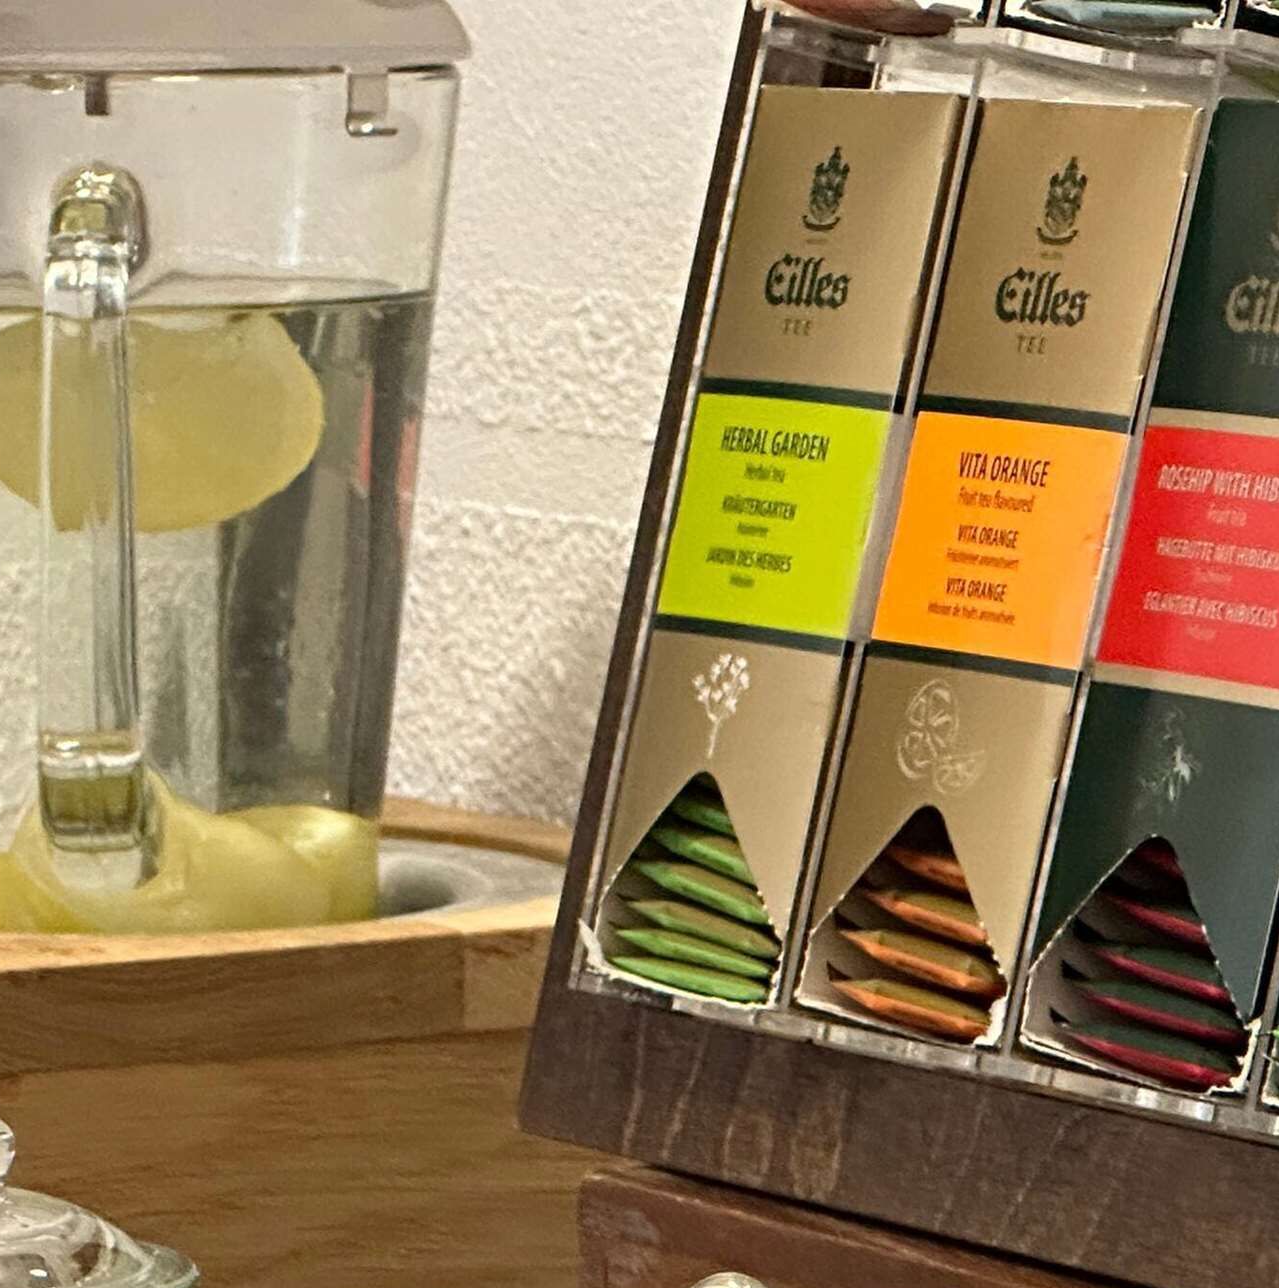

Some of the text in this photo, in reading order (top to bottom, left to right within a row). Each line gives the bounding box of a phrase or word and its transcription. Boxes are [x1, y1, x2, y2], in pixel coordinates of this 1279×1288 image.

[765, 253, 852, 310] Eilles
[996, 266, 1091, 327] Eilles
[782, 318, 813, 336] TEE
[1018, 334, 1048, 355] TEE
[1249, 343, 1279, 366] TEE
[721, 426, 831, 462] HERBAL GARDEN
[959, 452, 1051, 487] VITA ORANGE
[1158, 464, 1213, 492] ROSEHIP
[1214, 470, 1252, 498] WITH
[958, 524, 1019, 549] VITA ORANGE
[946, 577, 1007, 602] VITA ORANGE
